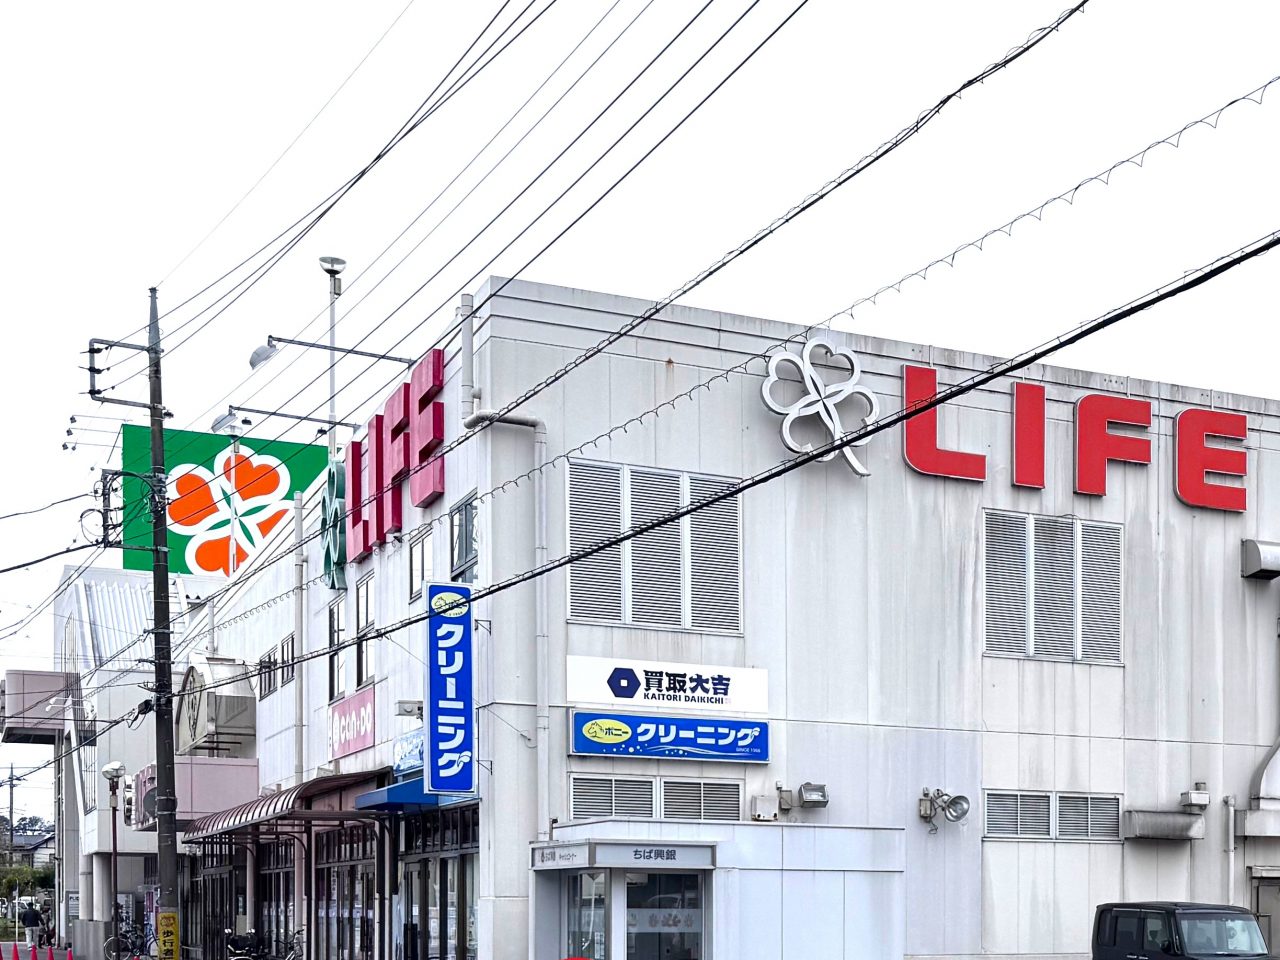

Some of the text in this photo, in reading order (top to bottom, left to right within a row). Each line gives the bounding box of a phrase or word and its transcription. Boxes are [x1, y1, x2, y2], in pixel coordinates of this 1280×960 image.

[903, 364, 1248, 512] LIFE
[345, 348, 444, 563] LIFE
[643, 670, 731, 696] 買取大吉
[436, 623, 471, 778] クリーニング
[643, 692, 724, 704] KAITORI DAIKICHI
[637, 723, 761, 746] クリーニング
[633, 849, 677, 861] ちば興銀
